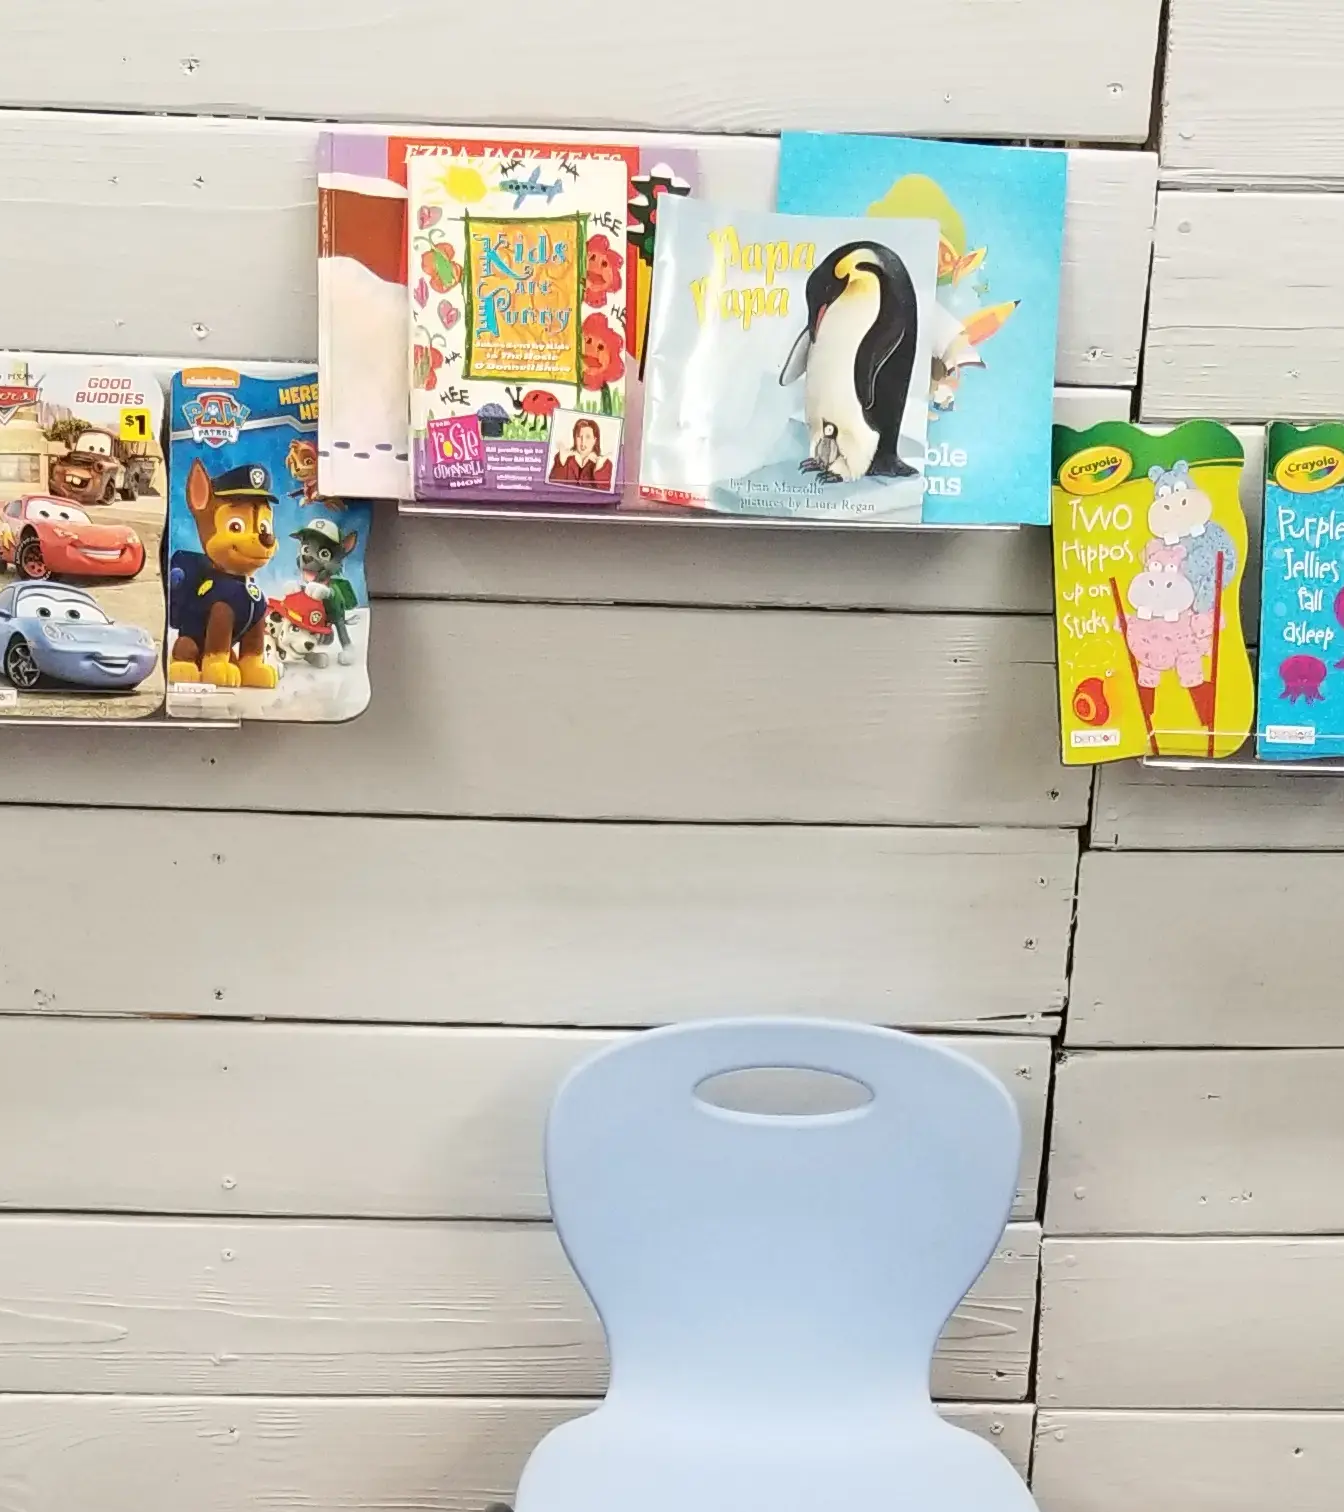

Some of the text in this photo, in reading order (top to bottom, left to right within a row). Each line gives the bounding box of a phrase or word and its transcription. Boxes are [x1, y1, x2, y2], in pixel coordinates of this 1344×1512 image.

[473, 234, 570, 280] Kids
[515, 281, 554, 294] are
[88, 378, 132, 390] GOOD
[75, 391, 145, 405] BUDDIES
[182, 399, 251, 428] PAW
[125, 414, 145, 436] $1
[198, 428, 234, 439] PATROL
[1070, 456, 1119, 475] Crayola
[1287, 456, 1336, 472] Crayola
[746, 479, 770, 492] Jean
[740, 496, 875, 514] pictures by Laura Regan
[1062, 540, 1135, 574] Hippos
[1283, 548, 1340, 583] Jellies
[1062, 584, 1113, 604] up on
[1282, 620, 1335, 651] asleep
